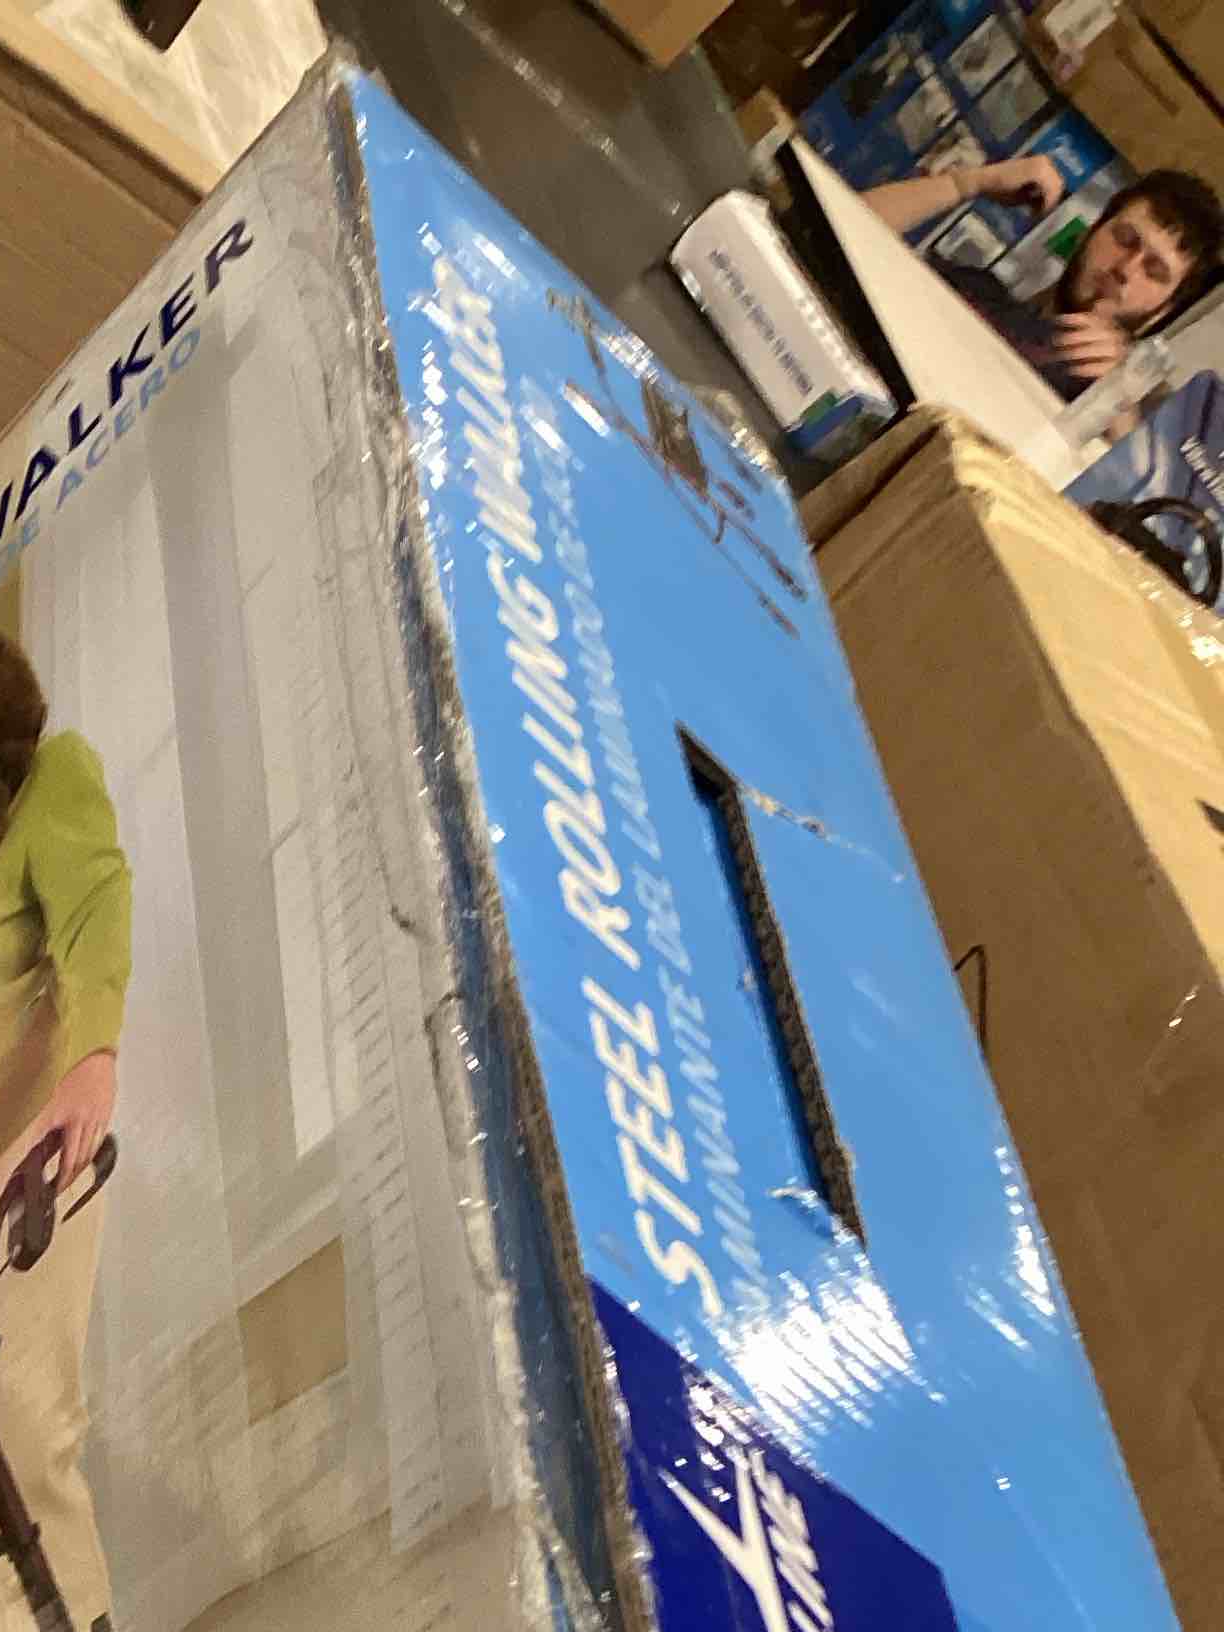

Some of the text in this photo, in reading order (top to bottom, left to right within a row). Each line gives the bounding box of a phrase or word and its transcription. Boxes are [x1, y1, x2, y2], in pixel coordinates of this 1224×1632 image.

[55, 328, 202, 511] ACERO
[431, 256, 544, 565] WALKER
[487, 547, 641, 971] ROLLING
[582, 976, 724, 1319] STEEL
